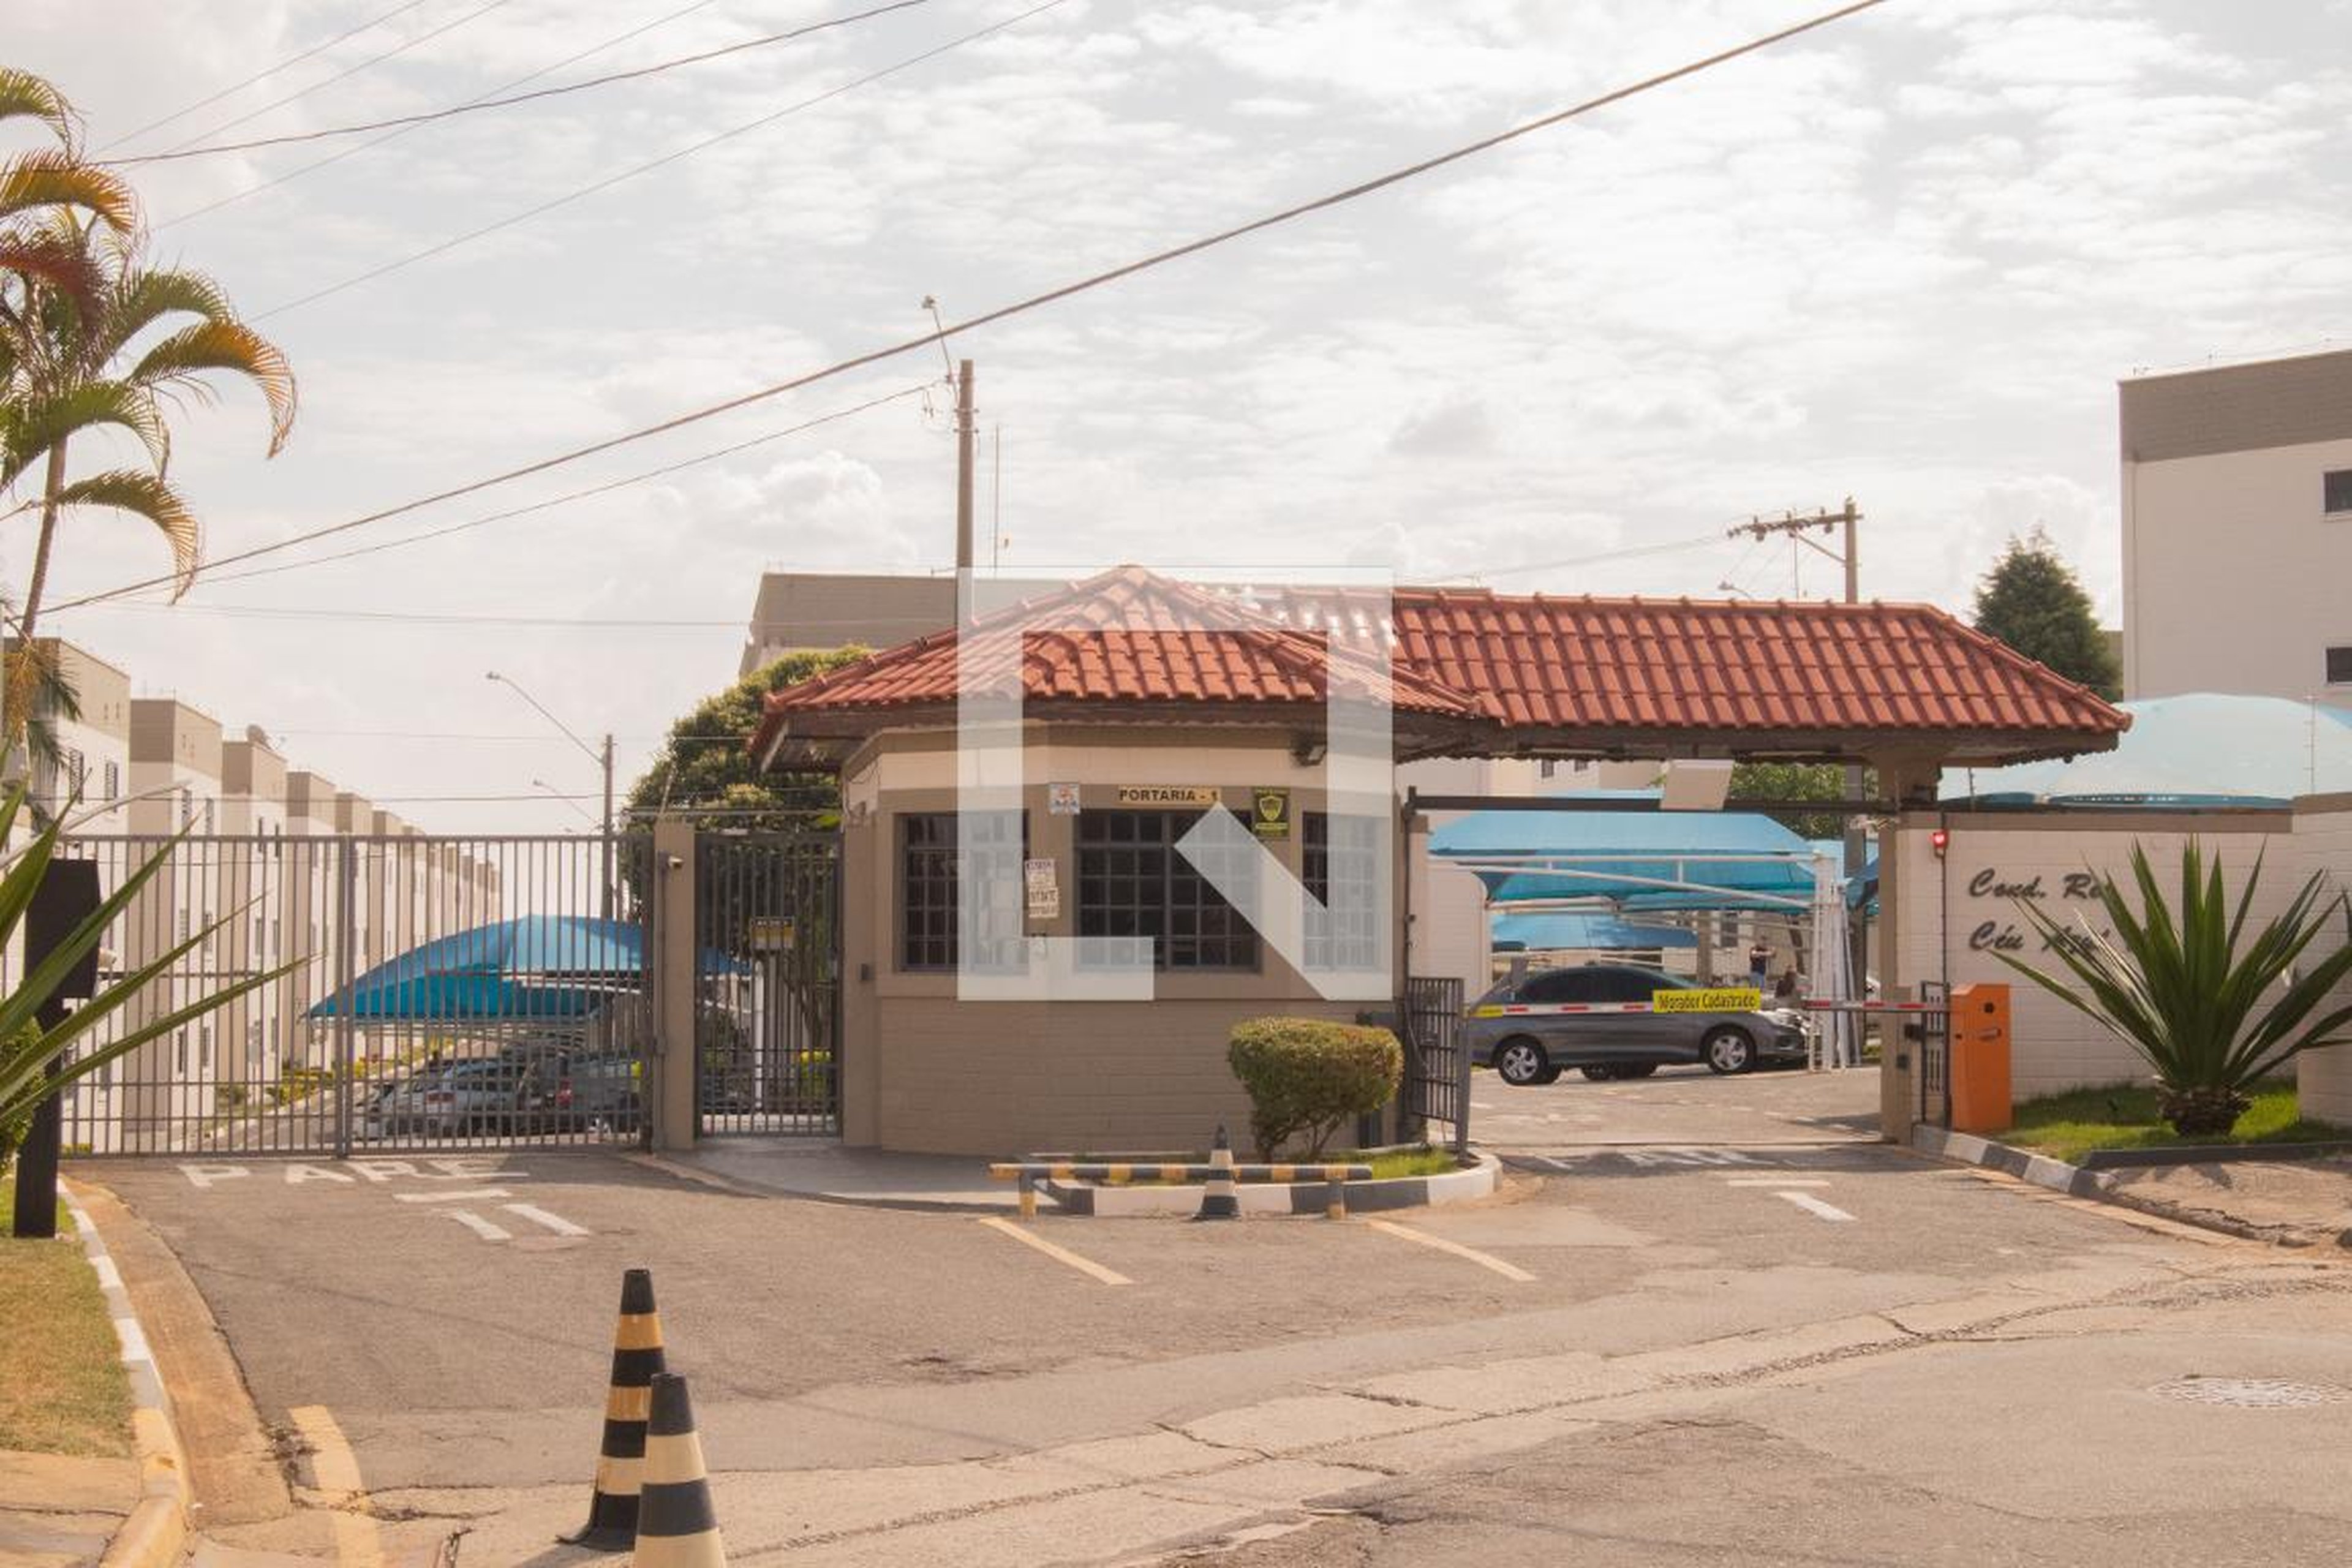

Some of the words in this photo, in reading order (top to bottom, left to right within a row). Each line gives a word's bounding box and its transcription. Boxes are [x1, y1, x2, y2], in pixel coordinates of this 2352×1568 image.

[1119, 789, 1195, 801] PORTARIA
[1969, 867, 2046, 898] Cond.
[1969, 921, 2024, 950] Céu
[177, 1160, 530, 1188] PARE
